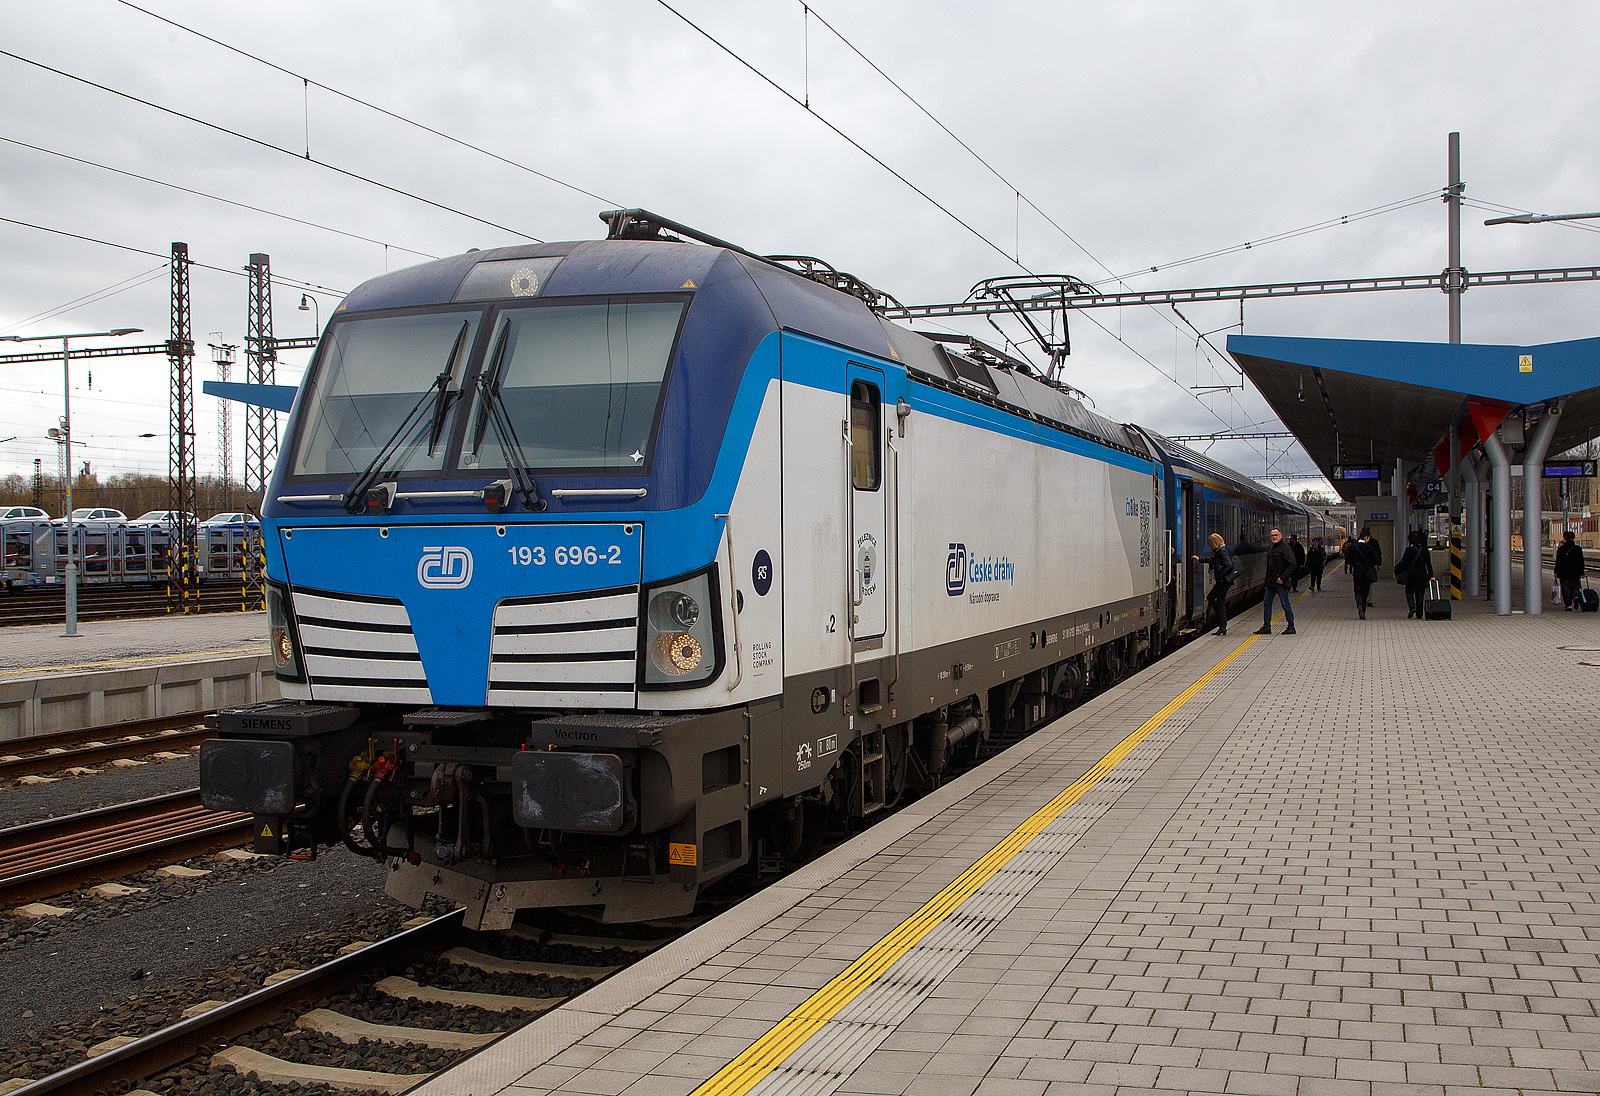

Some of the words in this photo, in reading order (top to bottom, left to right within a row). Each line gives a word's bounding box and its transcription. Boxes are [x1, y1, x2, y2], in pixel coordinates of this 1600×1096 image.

[1334, 467, 1341, 479] 4
[1584, 462, 1592, 475] 2
[508, 546, 547, 566] 193
[554, 545, 622, 566] 696-2
[969, 551, 992, 583] České
[993, 556, 1015, 586] dráhy
[829, 614, 836, 633] 2
[752, 641, 772, 651] ROLLING
[752, 651, 768, 660] STOCK
[752, 659, 774, 669] COMPANY
[241, 718, 292, 730] SIEMENS
[554, 728, 598, 741] Vectron
